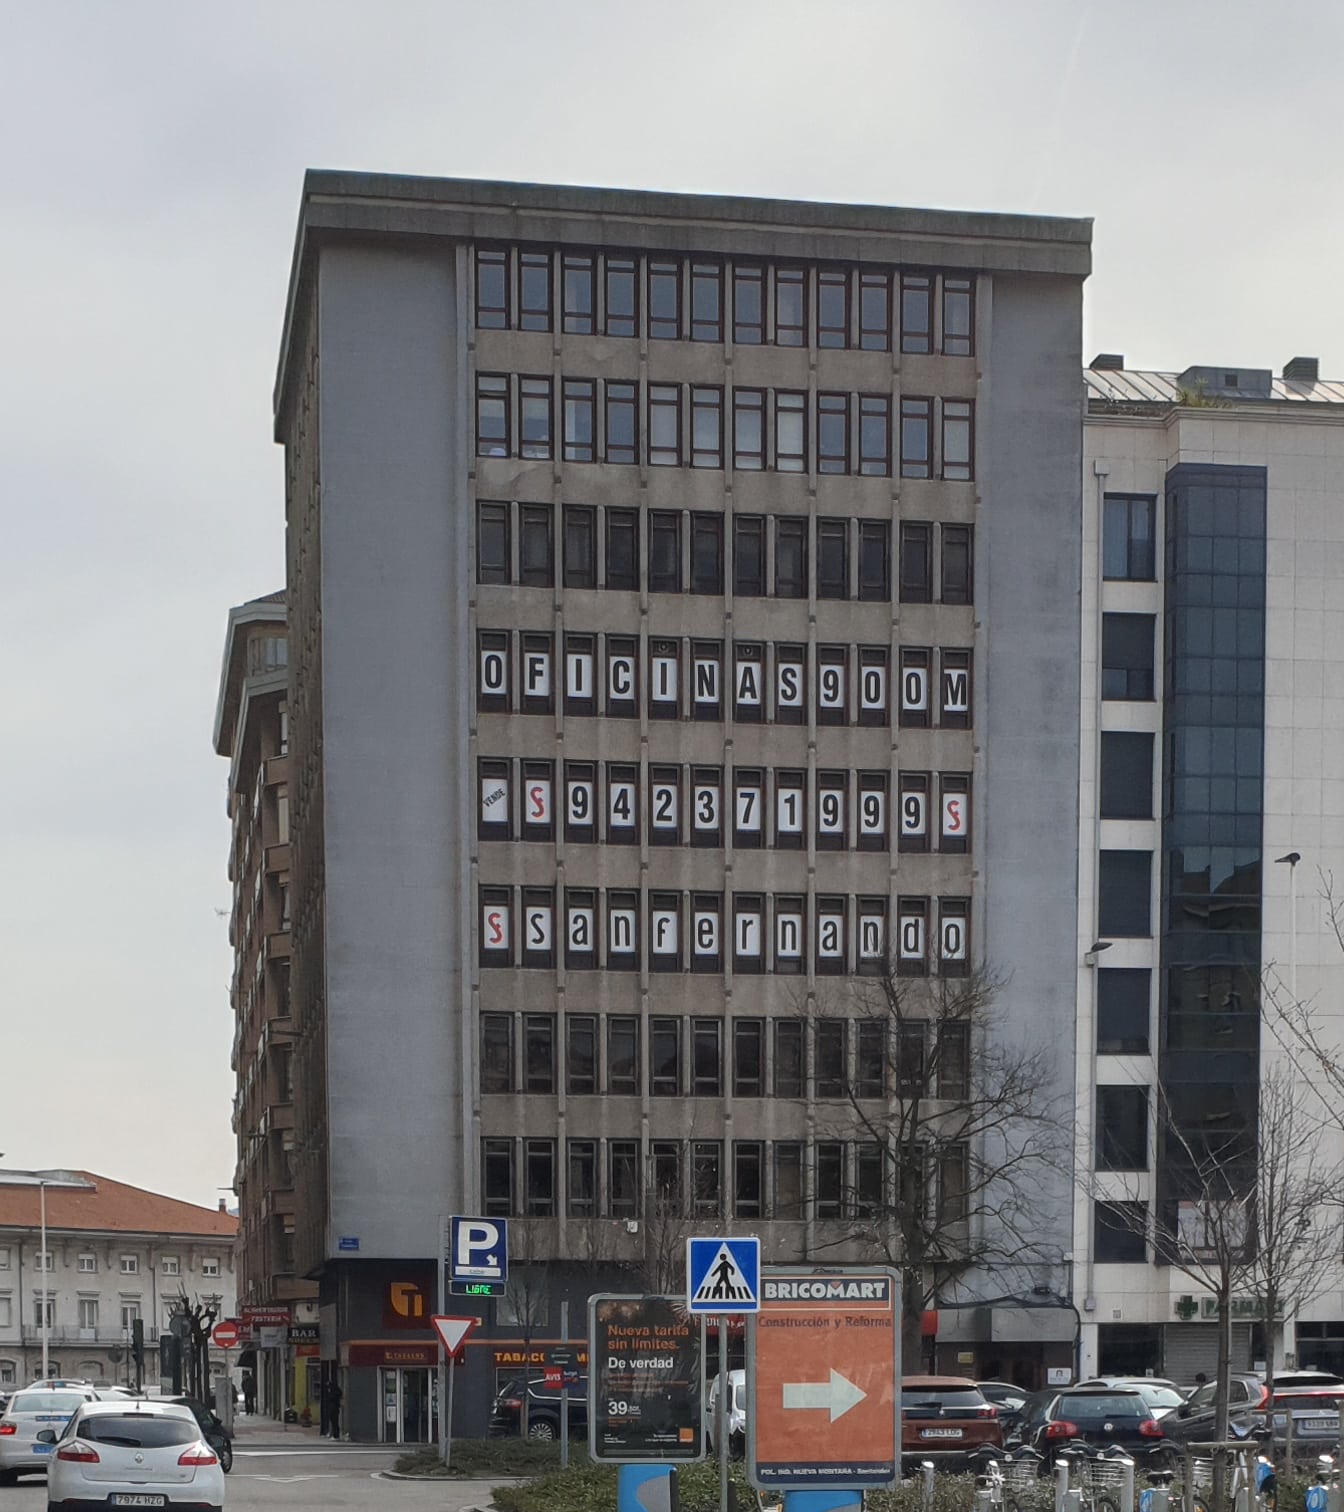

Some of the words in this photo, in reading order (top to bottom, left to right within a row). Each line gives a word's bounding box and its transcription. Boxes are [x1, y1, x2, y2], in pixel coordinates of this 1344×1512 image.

[482, 788, 506, 807] VENDE
[570, 787, 922, 830] 942371999
[457, 1221, 499, 1265] P
[465, 1284, 492, 1295] LIBRE
[764, 1281, 885, 1299] BRICOMART
[759, 1316, 829, 1328] Construcción
[834, 1318, 841, 1329] y
[845, 1316, 892, 1328] Reforma
[292, 1329, 316, 1337] BAR
[608, 1325, 650, 1336] Nueva
[654, 1325, 689, 1336] tarifa
[608, 1339, 627, 1350] sin
[608, 1357, 626, 1369] De
[630, 1357, 674, 1369] verdad
[545, 1373, 561, 1381] AVIS
[608, 1401, 628, 1415] 39
